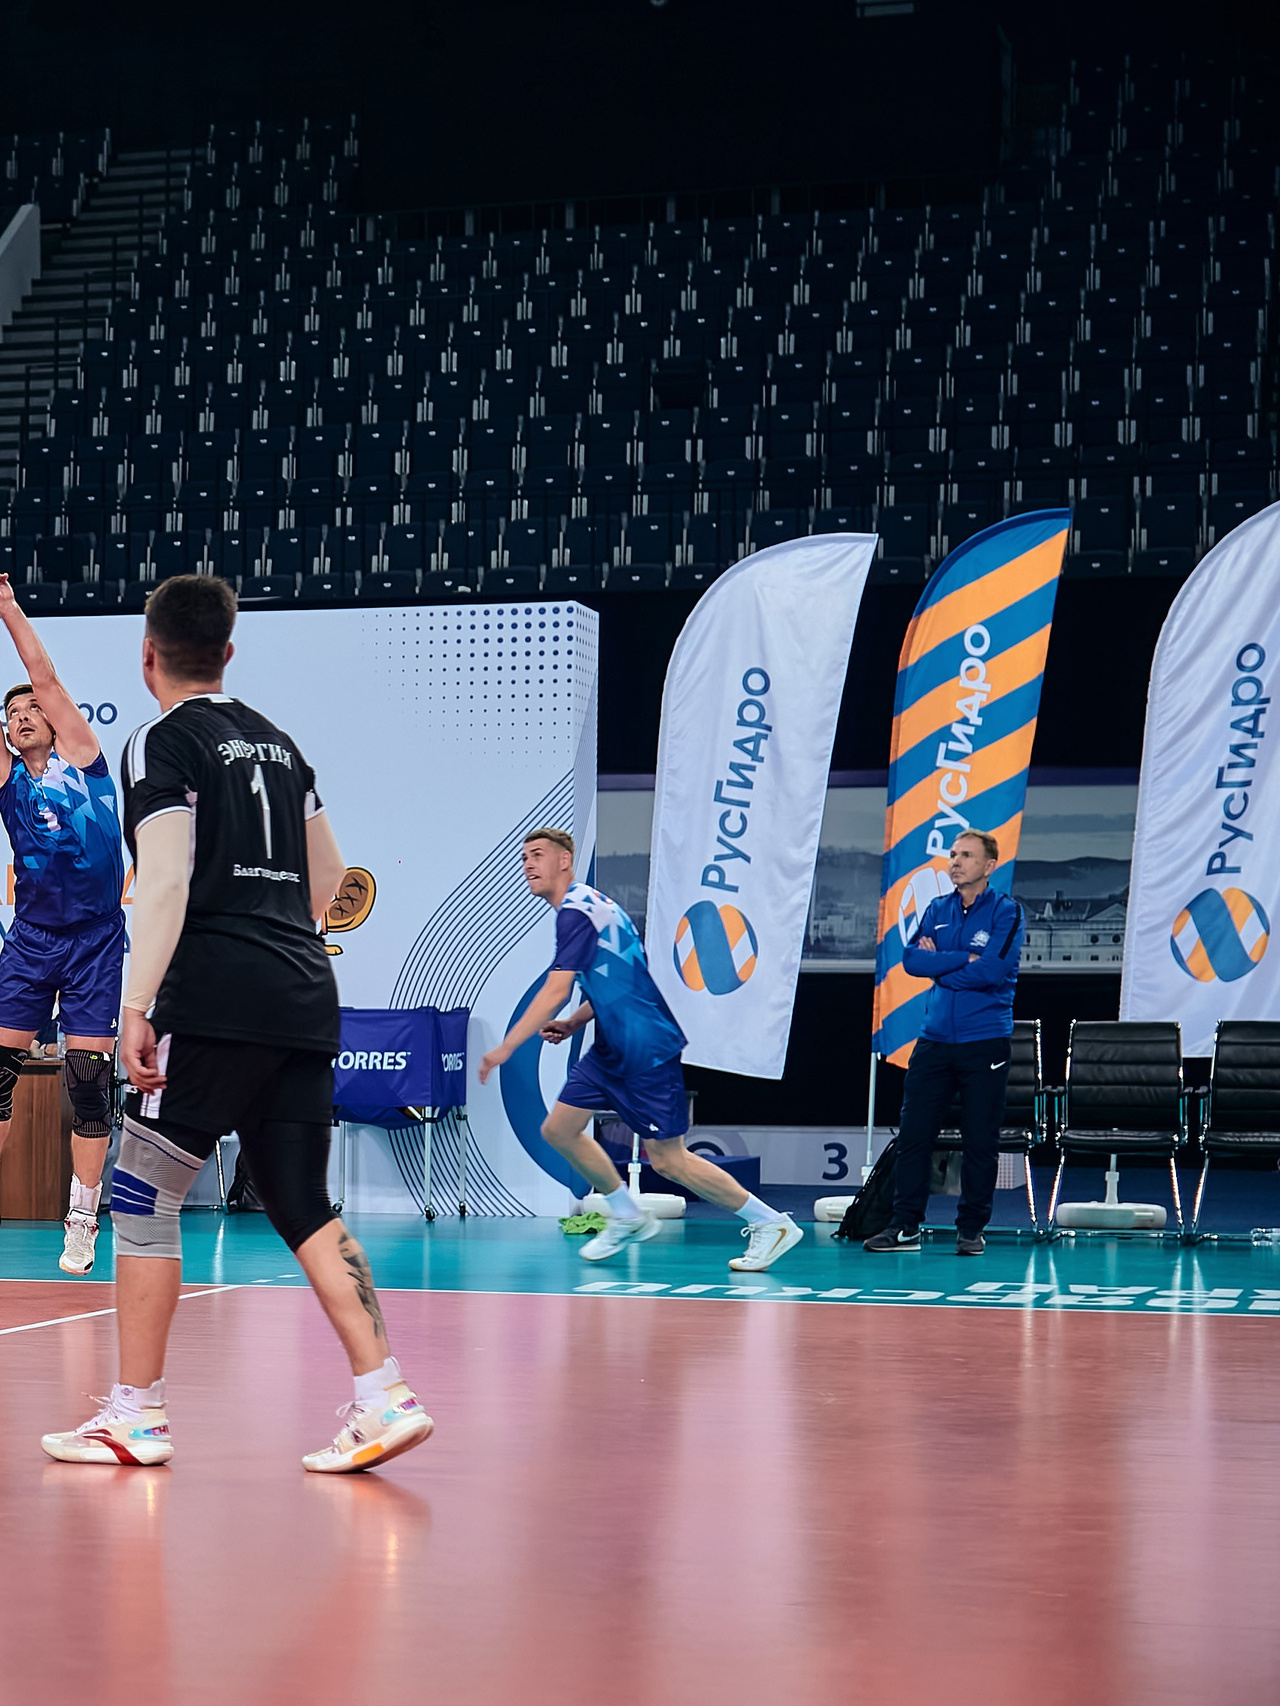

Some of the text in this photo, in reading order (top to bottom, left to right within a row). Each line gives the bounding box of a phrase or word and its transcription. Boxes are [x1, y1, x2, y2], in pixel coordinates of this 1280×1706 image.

[250, 764, 272, 860] 1
[701, 667, 773, 893] РусГидро
[926, 623, 992, 858] РусГидро
[1206, 642, 1272, 876] РусГидро
[332, 1051, 407, 1070] ORRES
[821, 1141, 849, 1181] 3
